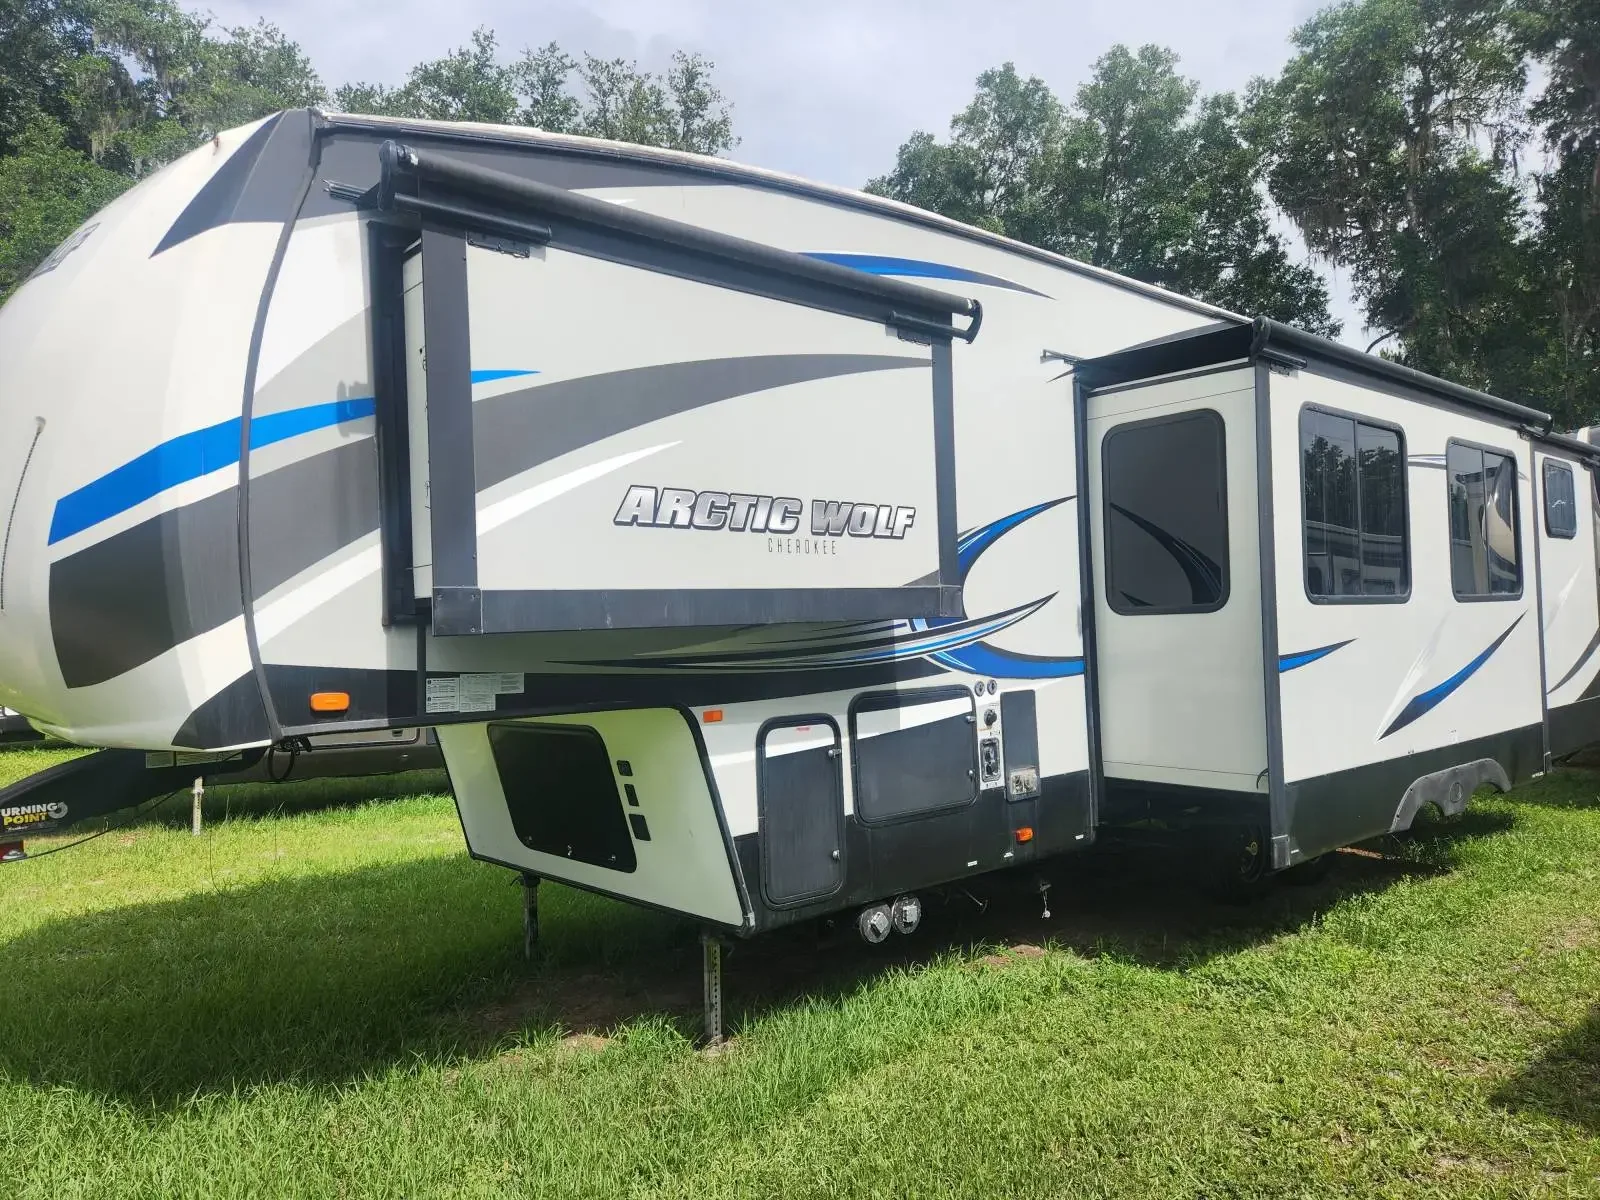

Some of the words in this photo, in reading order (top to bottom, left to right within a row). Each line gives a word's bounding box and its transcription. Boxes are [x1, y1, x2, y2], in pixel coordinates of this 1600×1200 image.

[613, 485, 803, 534] ARCTIC
[811, 499, 916, 540] WOLF
[767, 537, 837, 556] CHEROKEE
[0, 803, 57, 817] URNING
[3, 812, 47, 825] POINT
